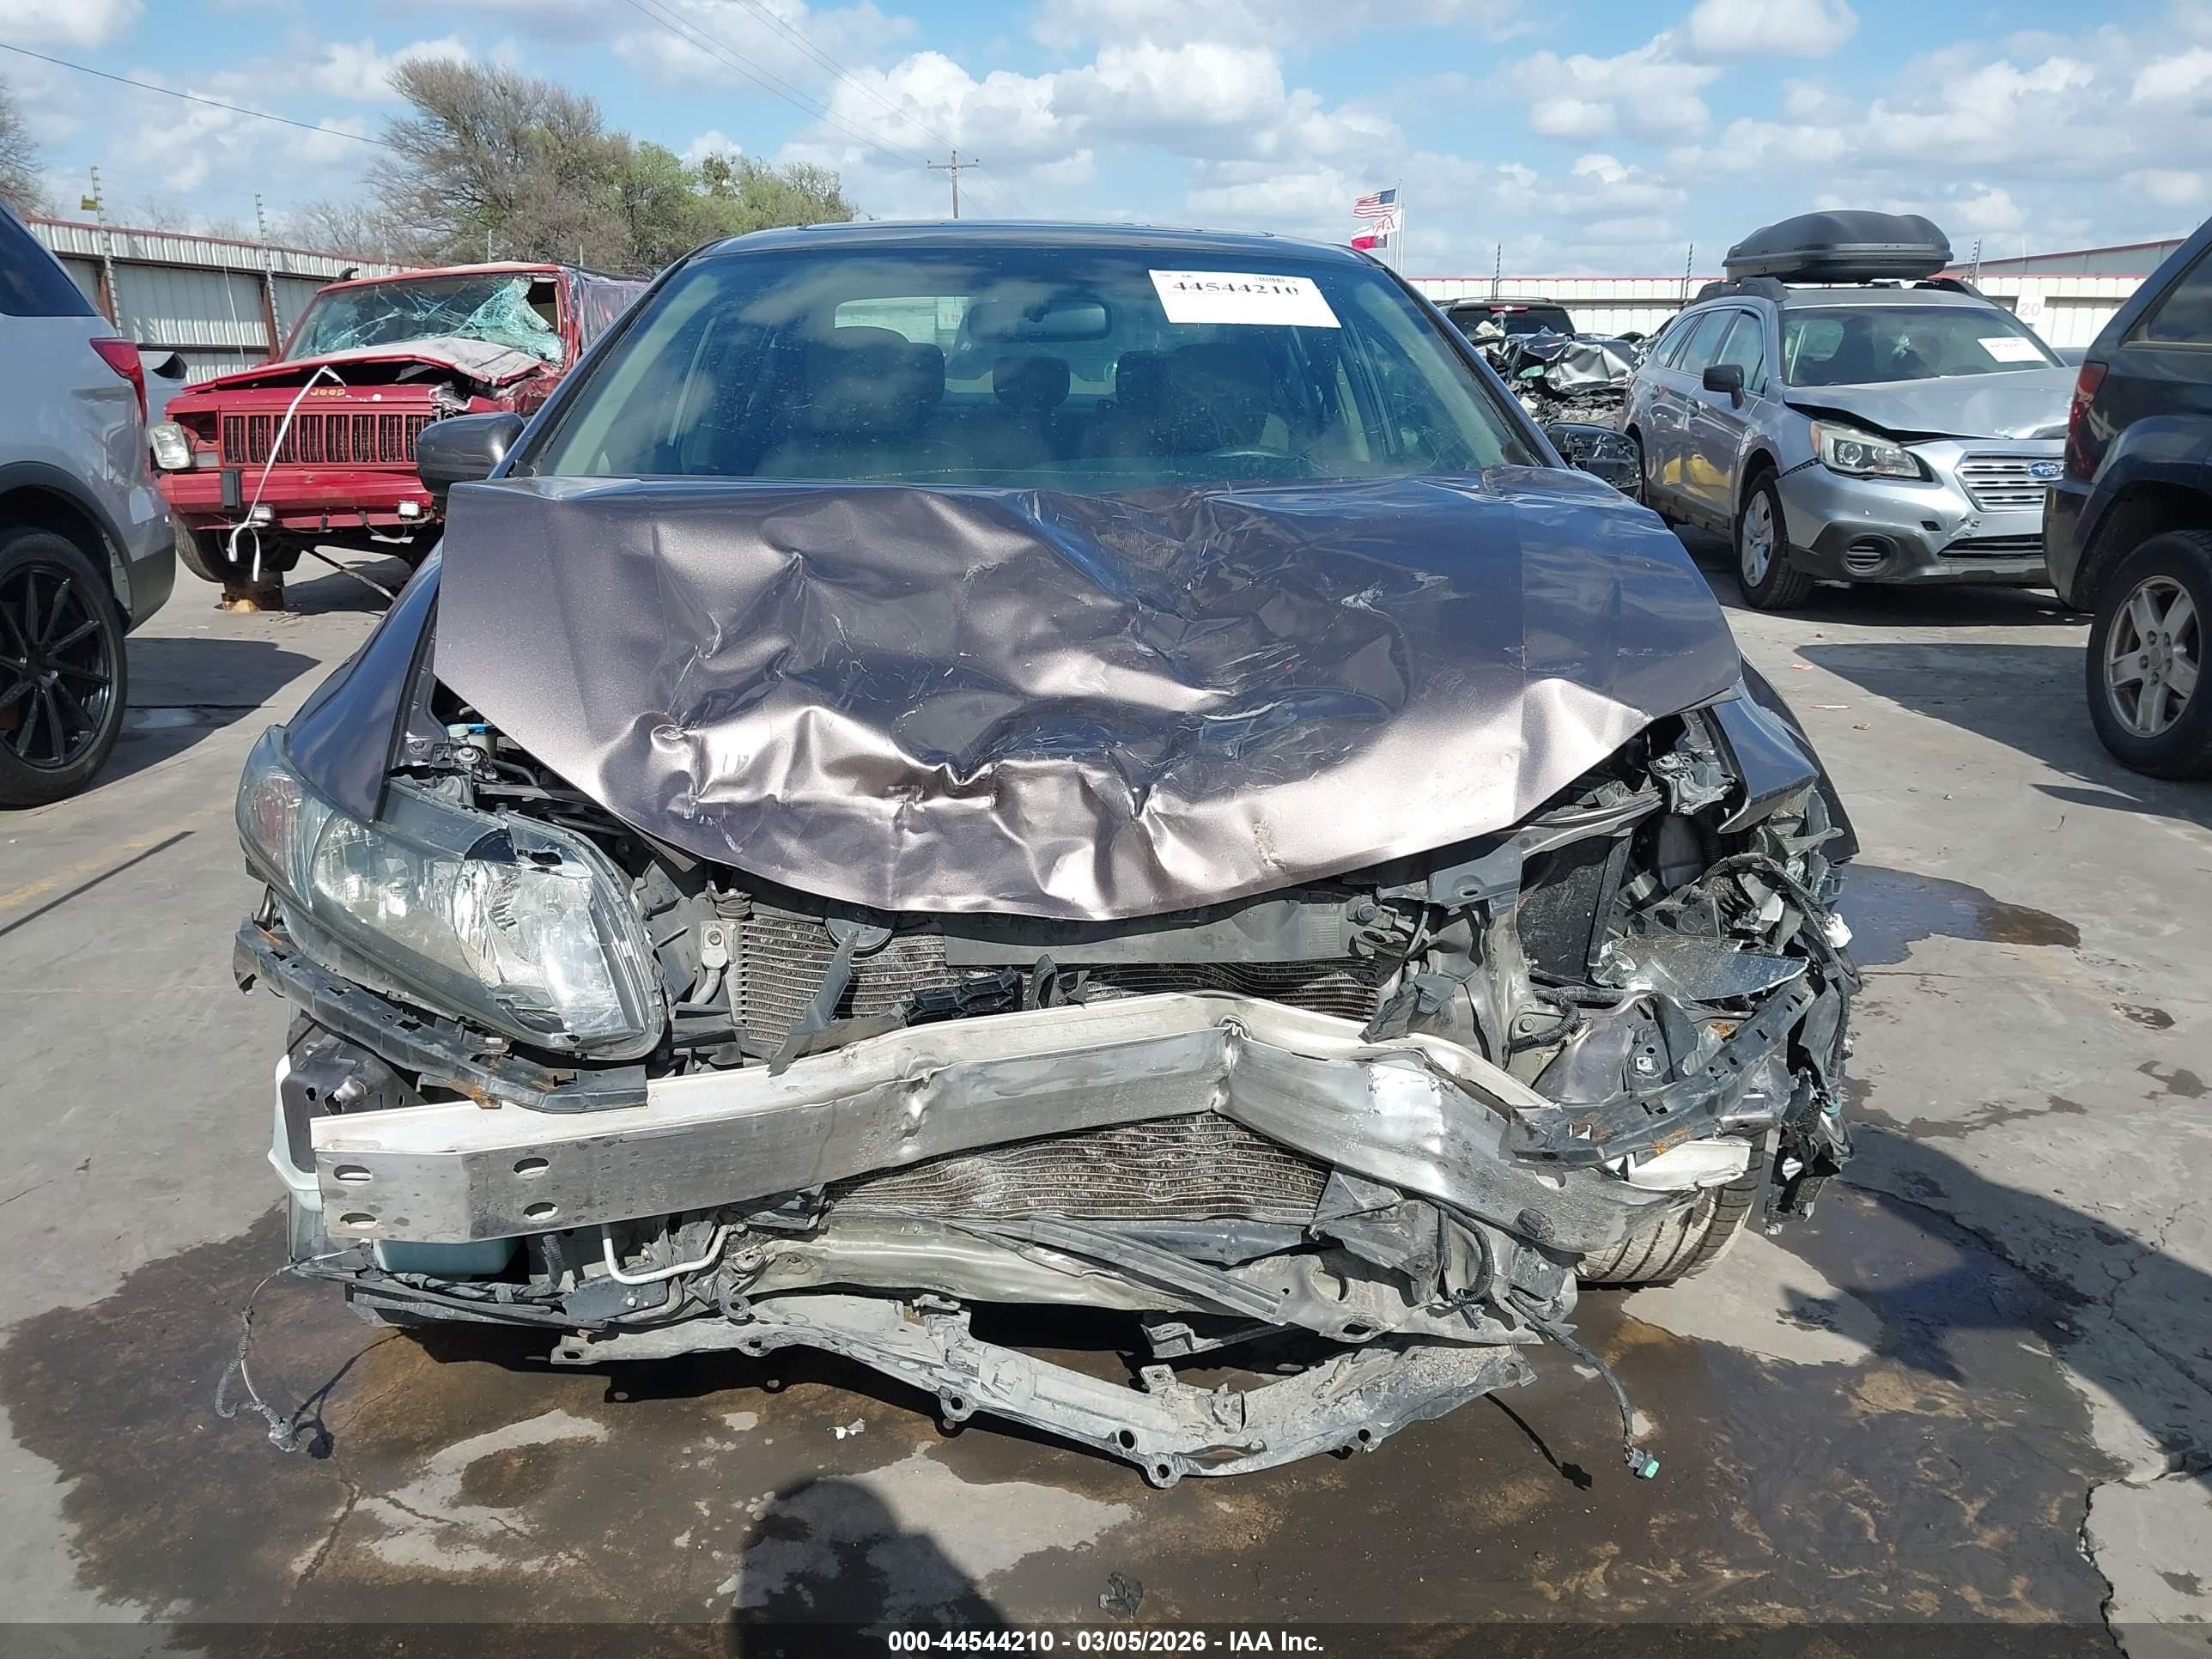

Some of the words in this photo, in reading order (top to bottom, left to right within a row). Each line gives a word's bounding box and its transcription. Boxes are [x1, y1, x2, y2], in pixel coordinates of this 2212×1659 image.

[1173, 282, 1299, 295] 44544210
[2020, 303, 2041, 316] 20
[310, 388, 345, 397] Jeep
